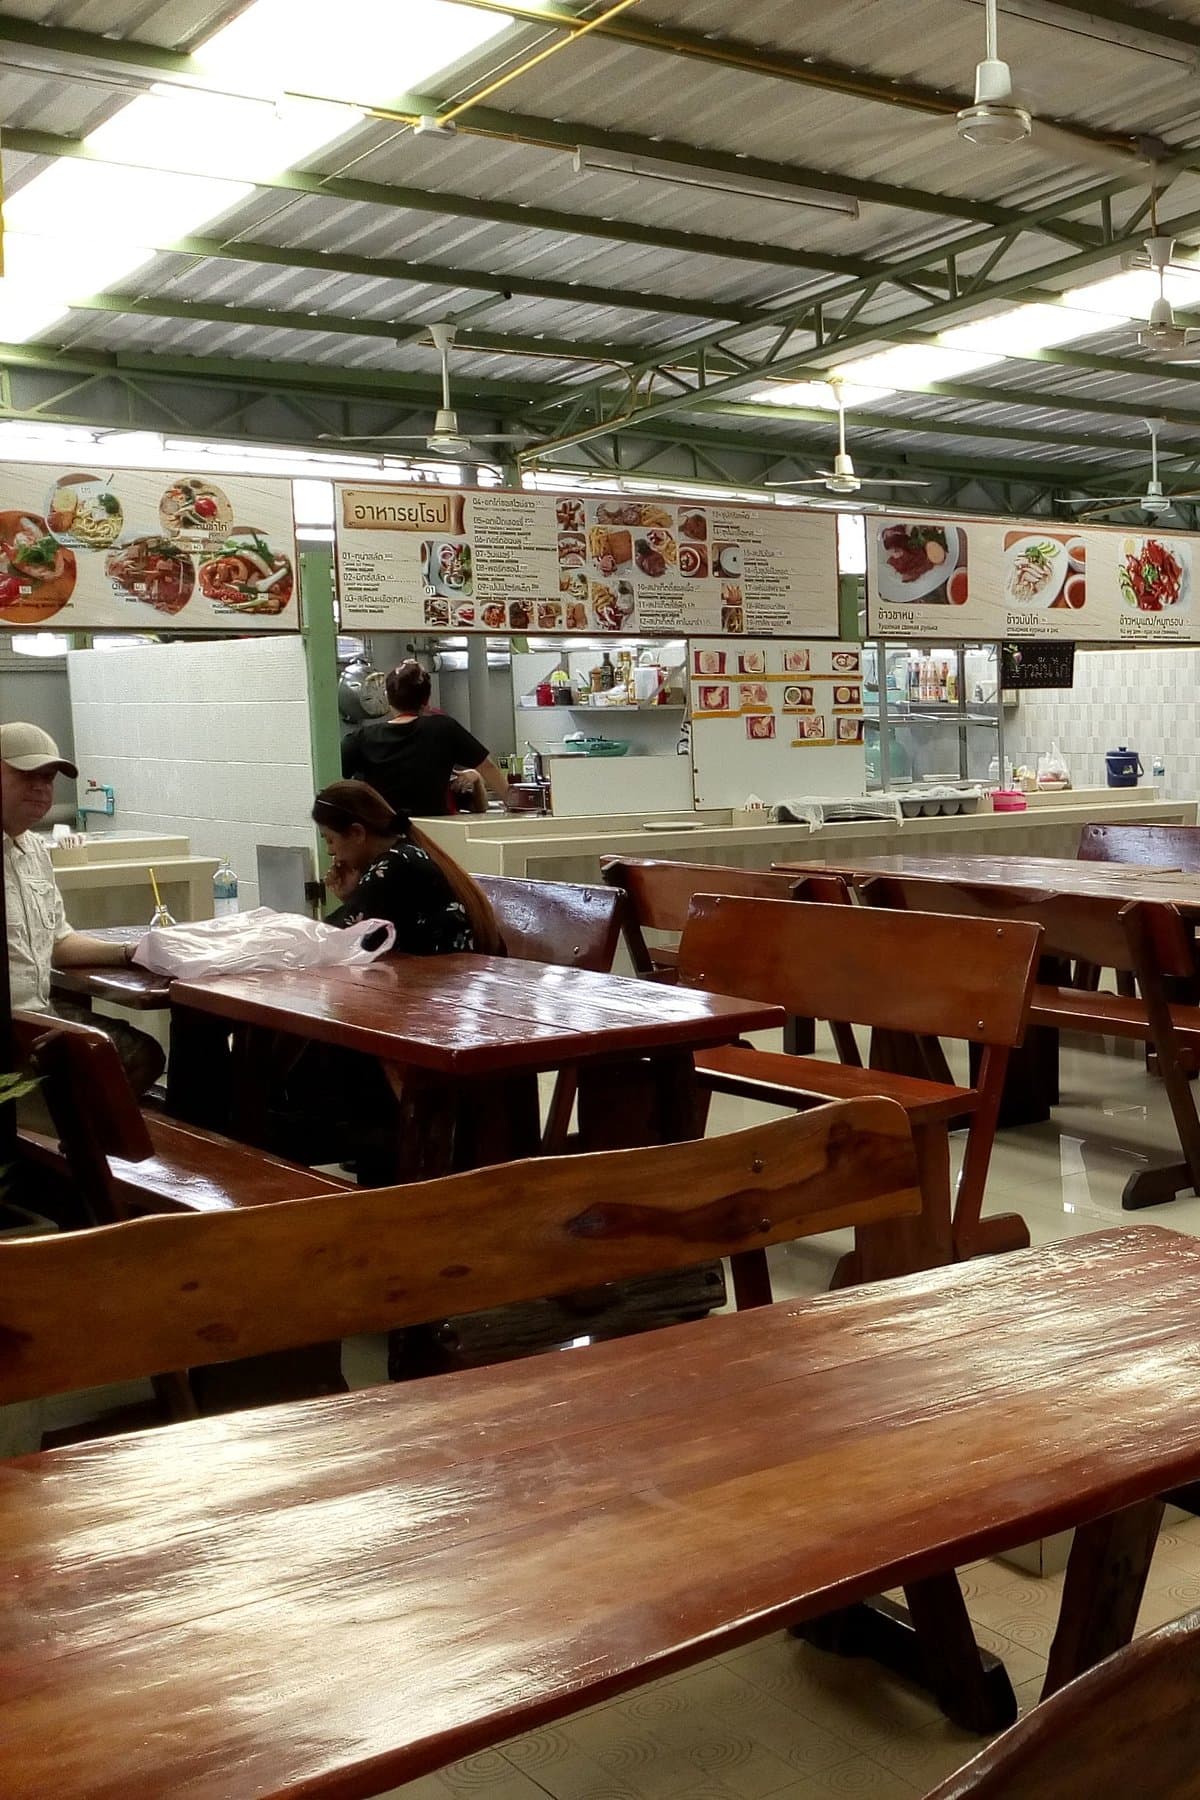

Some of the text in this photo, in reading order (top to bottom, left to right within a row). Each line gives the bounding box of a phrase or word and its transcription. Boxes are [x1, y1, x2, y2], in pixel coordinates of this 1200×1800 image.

[354, 502, 447, 529] อาหารยุโรป
[878, 607, 914, 624] ข้าวขาหมู
[1006, 612, 1039, 625] ข้าวมันไก่
